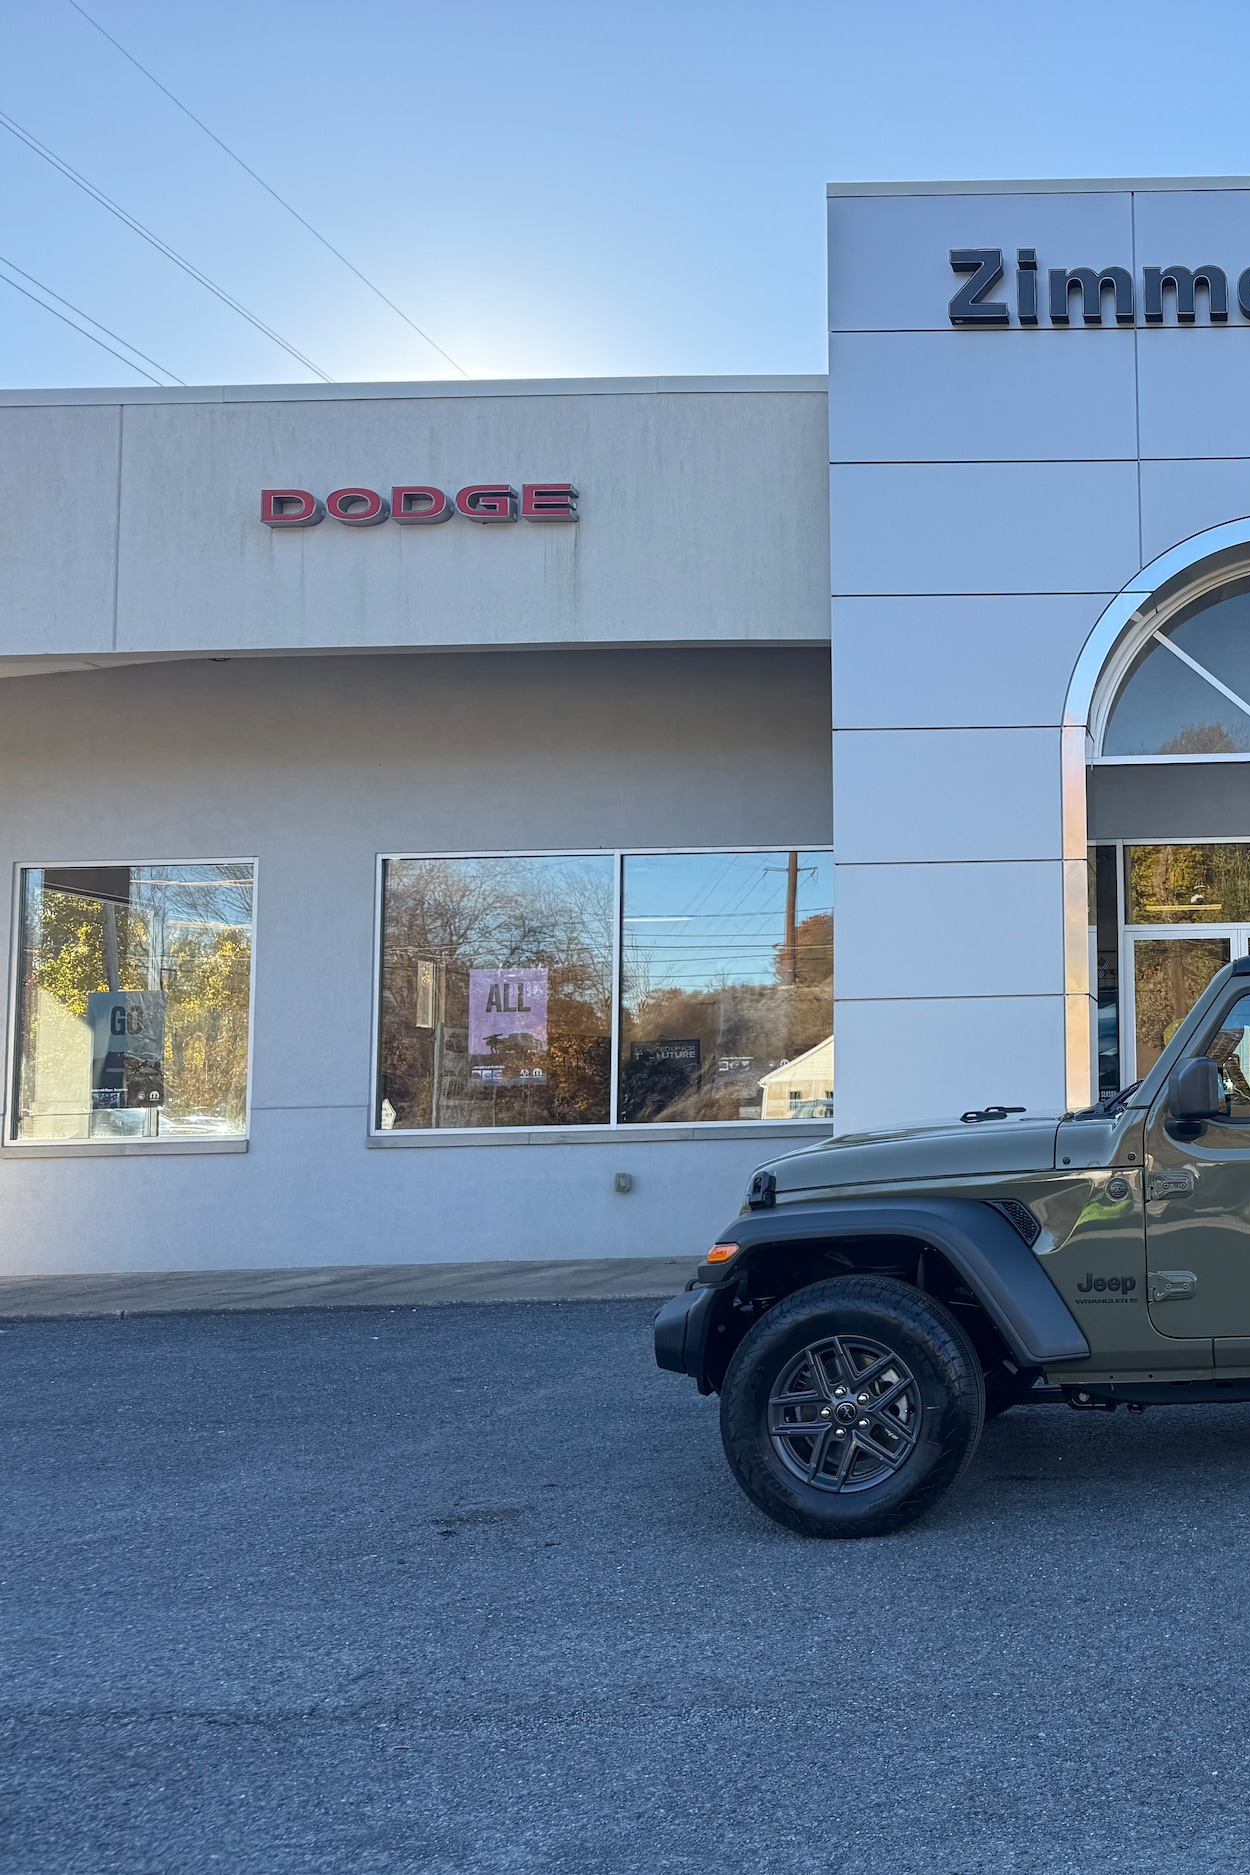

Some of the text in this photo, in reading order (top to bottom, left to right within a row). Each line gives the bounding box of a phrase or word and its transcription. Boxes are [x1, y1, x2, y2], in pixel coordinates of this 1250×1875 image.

[260, 483, 580, 528] DODGE
[485, 982, 532, 1013] ALL
[110, 1005, 144, 1036] GO
[1077, 1272, 1136, 1295] Jeep
